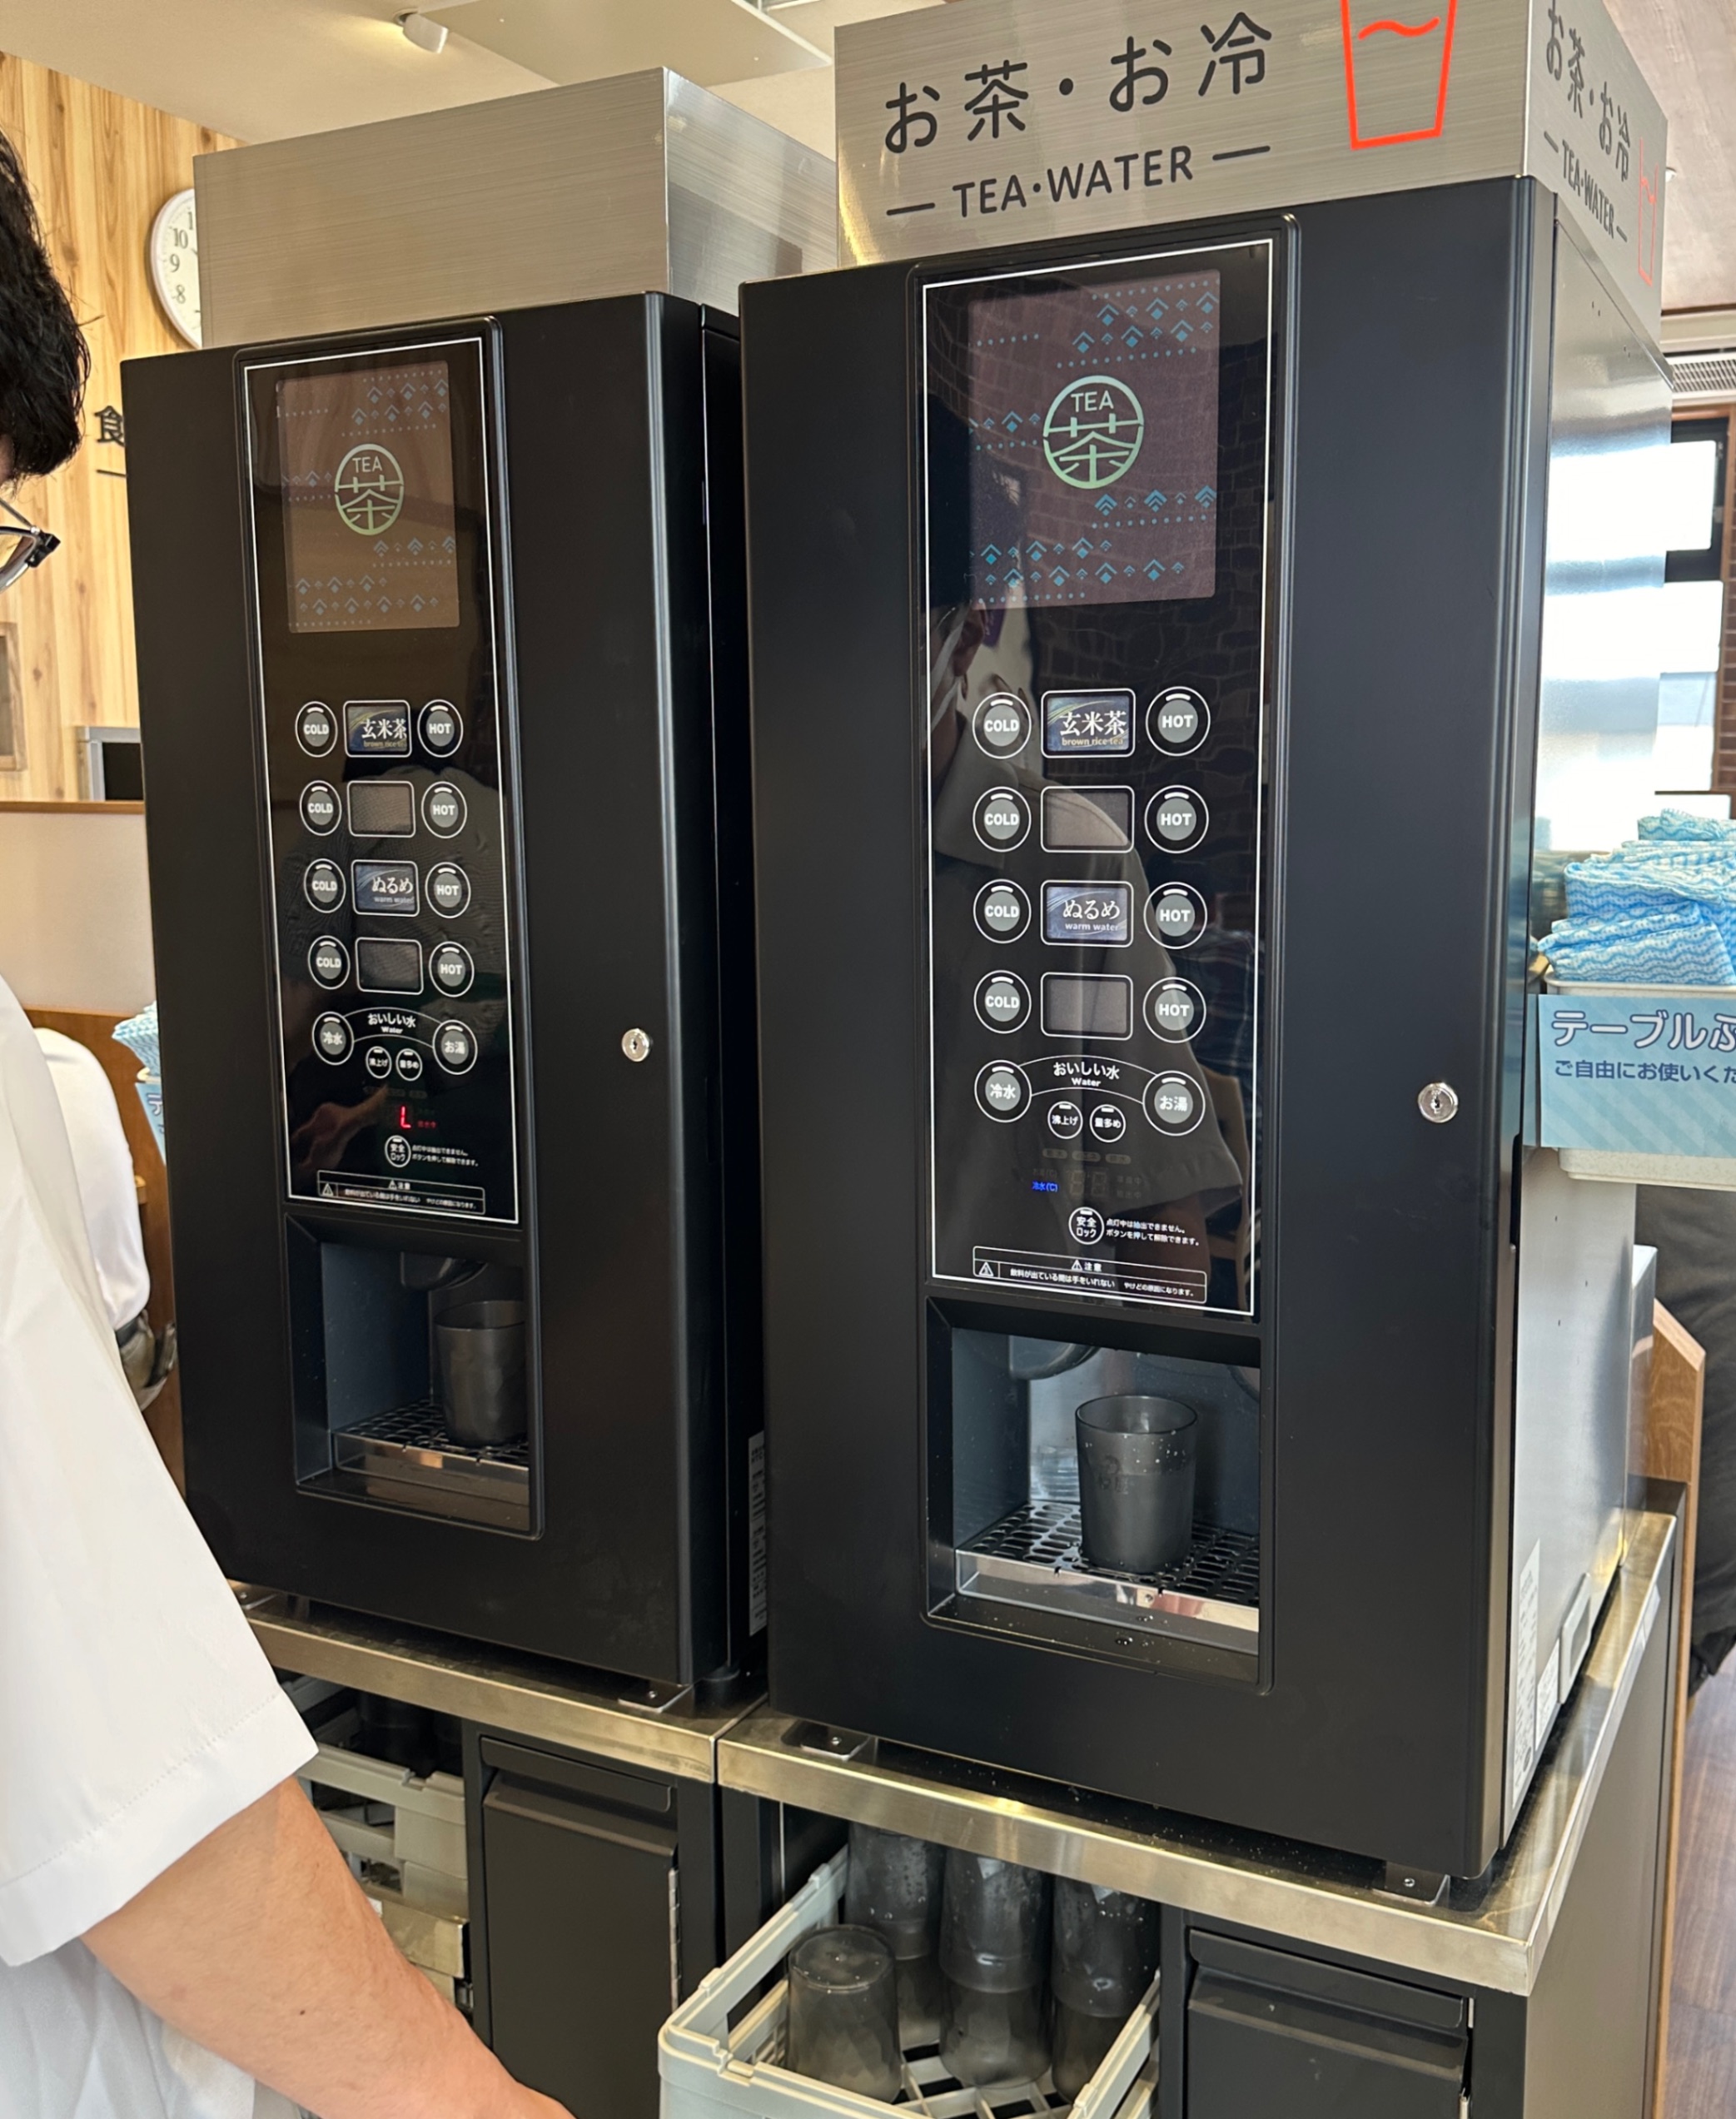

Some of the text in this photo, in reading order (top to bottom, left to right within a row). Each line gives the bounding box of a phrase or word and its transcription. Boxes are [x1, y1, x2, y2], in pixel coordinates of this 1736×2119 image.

[885, 12, 1272, 153] お茶・お冷
[1546, 7, 1630, 182] お茶・お冷
[173, 227, 189, 250] 10
[169, 253, 181, 273] 9
[175, 284, 187, 305] 8
[1070, 390, 1115, 413] TEA
[351, 456, 383, 473] TEA
[984, 719, 1020, 733] COLD
[1059, 710, 1127, 736] 玄米茶
[1161, 714, 1194, 729] HOT
[303, 724, 330, 735] COLD
[361, 719, 408, 739] 玄米茶
[429, 723, 451, 734] HOT
[1062, 736, 1123, 746] brown rice tea
[307, 803, 333, 813] COLD
[432, 804, 455, 816] HOT
[984, 813, 1020, 826] COLD
[1161, 813, 1192, 826] HOT
[311, 880, 337, 891] COLD
[371, 877, 414, 894] ぬるめ
[436, 885, 460, 896] HOT
[984, 905, 1020, 918] COLD
[1062, 899, 1121, 920] ぬるめ
[1159, 909, 1191, 923] HOT
[1065, 922, 1119, 932] warm water
[316, 957, 341, 968] COLD
[440, 964, 463, 976] HOT
[985, 995, 1020, 1009] COLD
[1158, 1003, 1190, 1017] HOT
[367, 1012, 416, 1028] おいしい水
[381, 1026, 403, 1034] Water
[323, 1032, 343, 1045] 冷水
[444, 1041, 465, 1054] お湯
[1053, 1062, 1120, 1080] おいしい水
[1071, 1077, 1102, 1087] Water
[989, 1083, 1017, 1101] 冷水
[1159, 1096, 1188, 1112] お湯
[400, 1106, 412, 1128] L
[390, 1143, 405, 1153] 安全
[390, 1152, 405, 1161] ロック
[1076, 1216, 1097, 1228] 安全
[1076, 1227, 1097, 1238] ロック
